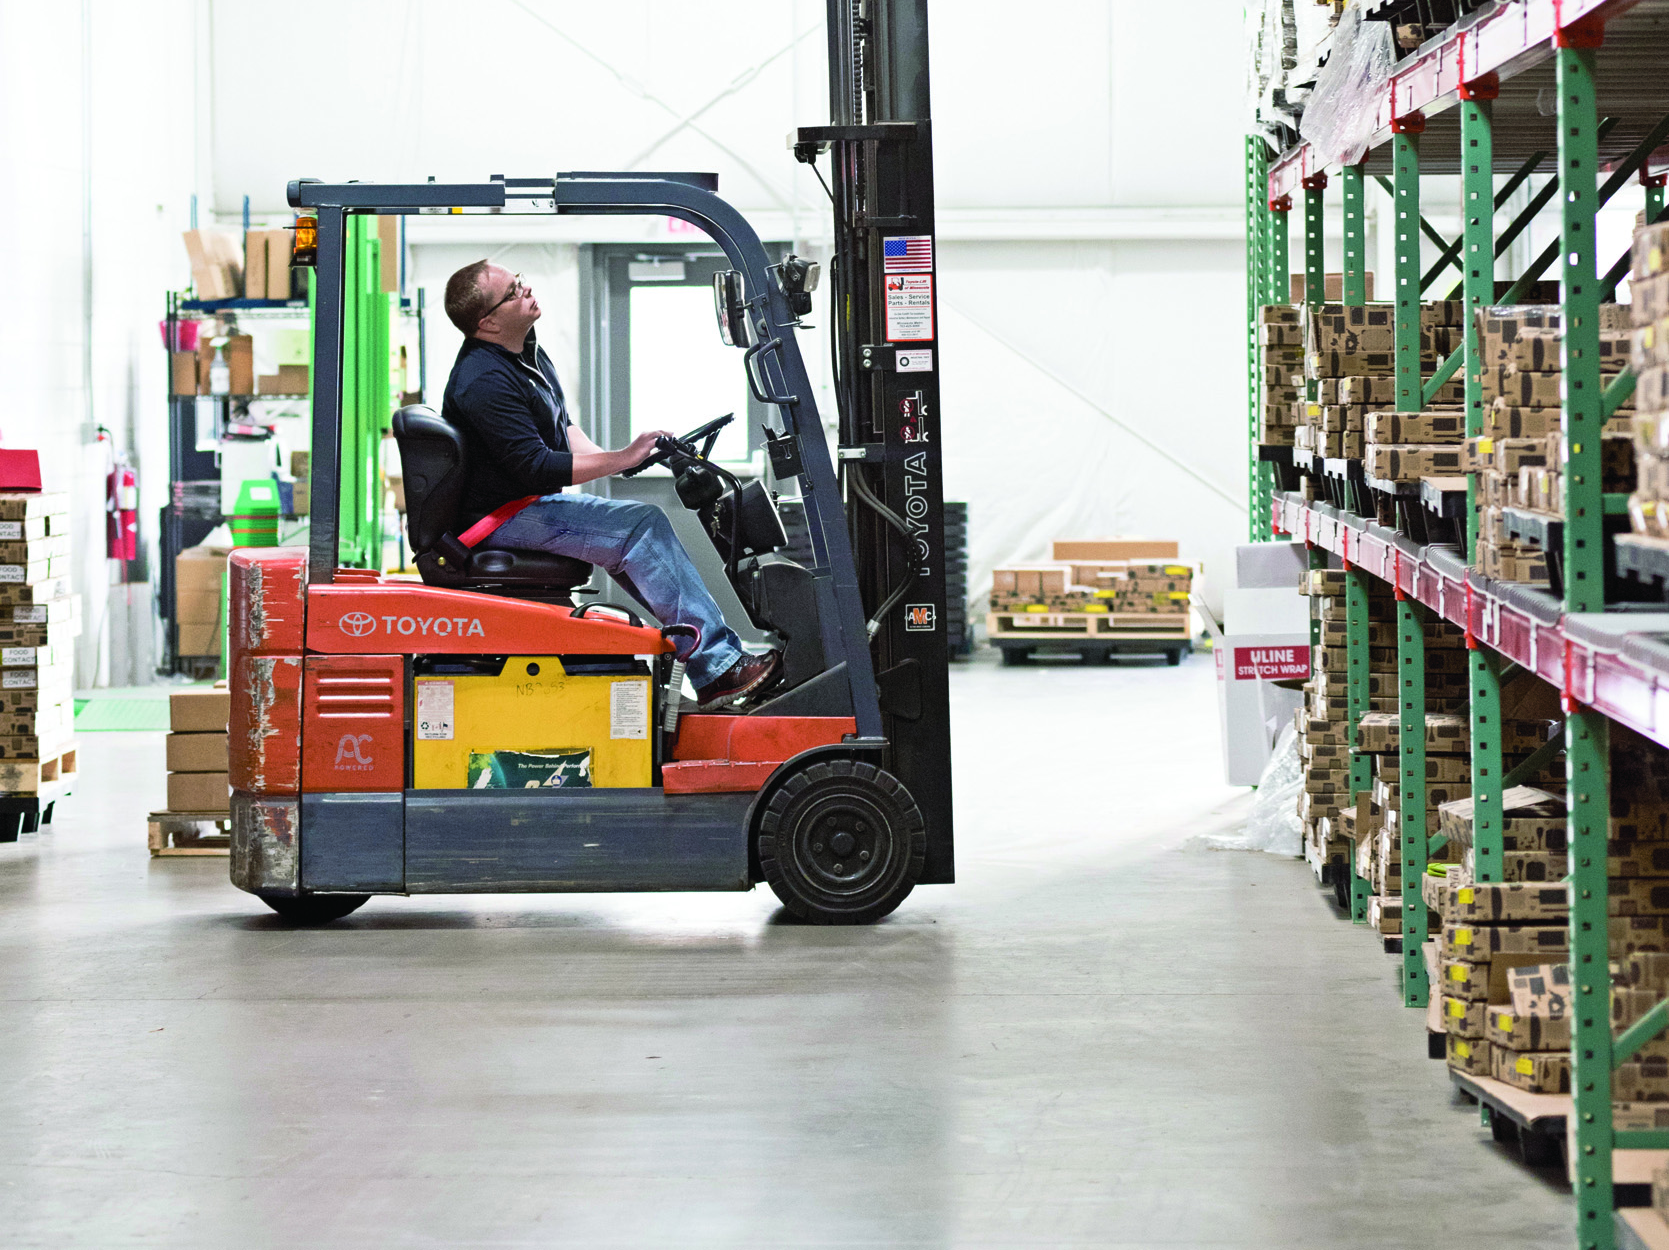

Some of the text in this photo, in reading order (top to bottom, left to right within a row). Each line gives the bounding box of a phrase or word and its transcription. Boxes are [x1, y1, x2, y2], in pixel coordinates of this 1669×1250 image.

[905, 451, 930, 576] YOTA
[908, 607, 932, 625] AMC
[381, 615, 485, 637] TOYOTA
[3, 656, 35, 664] CONTACT
[1250, 650, 1294, 663] ULINE
[10, 671, 30, 679] FOOD
[1238, 664, 1308, 675] STRTCH WRAP
[3, 678, 35, 686] CONTACT
[335, 734, 373, 764] AC
